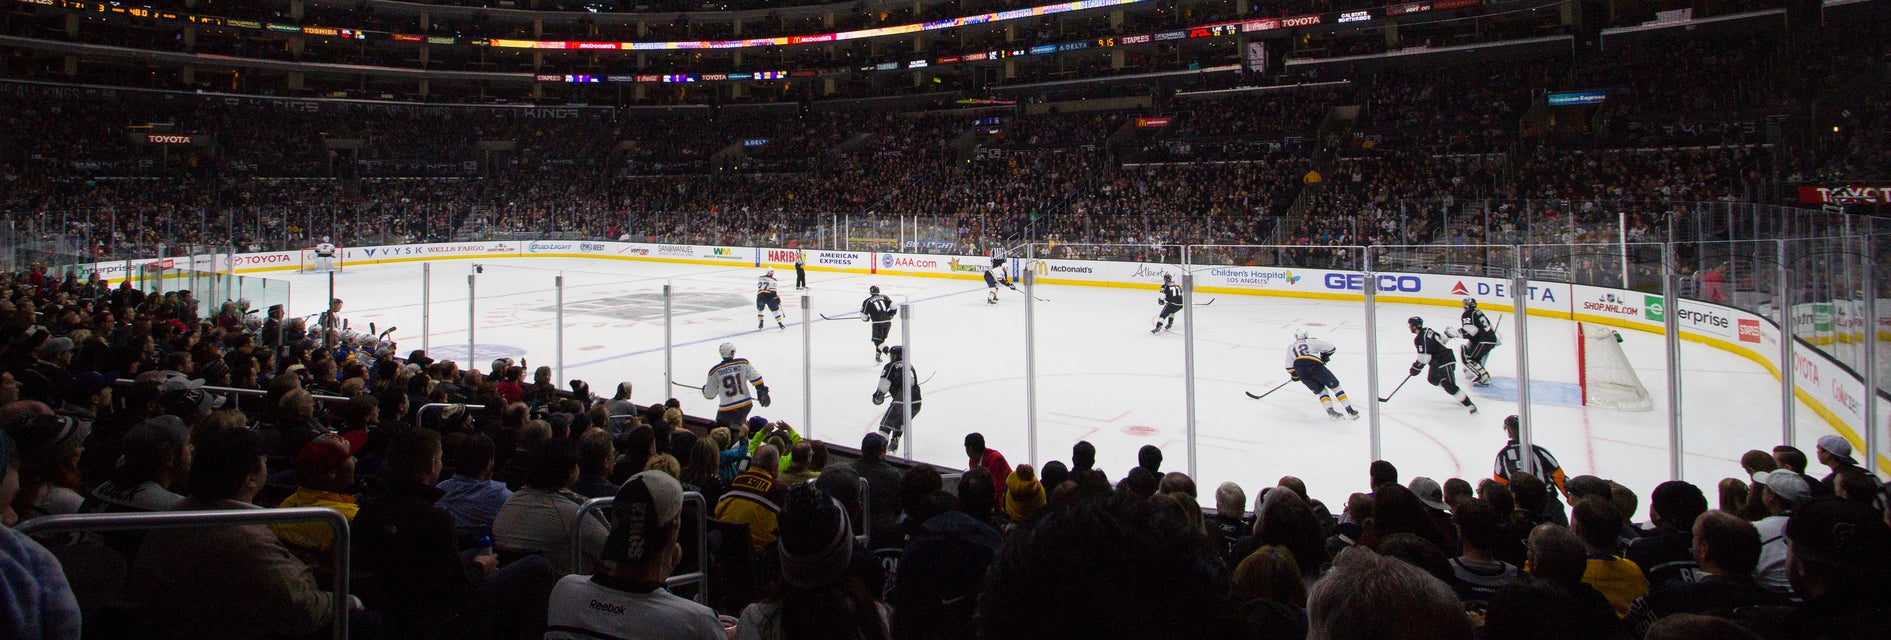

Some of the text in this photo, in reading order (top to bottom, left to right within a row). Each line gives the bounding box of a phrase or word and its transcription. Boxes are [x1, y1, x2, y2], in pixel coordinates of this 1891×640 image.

[98, 4, 105, 12] 3
[1282, 16, 1321, 26] TOYOTA
[304, 27, 338, 36] TOSHIBA
[801, 36, 832, 44] McDonald's
[1122, 36, 1150, 45] STAPLES
[962, 53, 987, 61] TOSHIBA
[1550, 96, 1579, 104] American
[149, 135, 191, 144] TOYOTA
[245, 254, 290, 263] TOYOTA
[768, 251, 795, 262] HARIB
[895, 257, 937, 268] AAA.com
[1051, 265, 1092, 274] McDonald's
[1211, 269, 1285, 280] Children's Hospital
[1325, 273, 1422, 292] GECO
[874, 301, 887, 312] 11
[1584, 301, 1638, 316] SHOP.NHL.COM
[1294, 343, 1309, 354] 12
[722, 373, 744, 397] 91
[589, 599, 627, 616] Reebok
